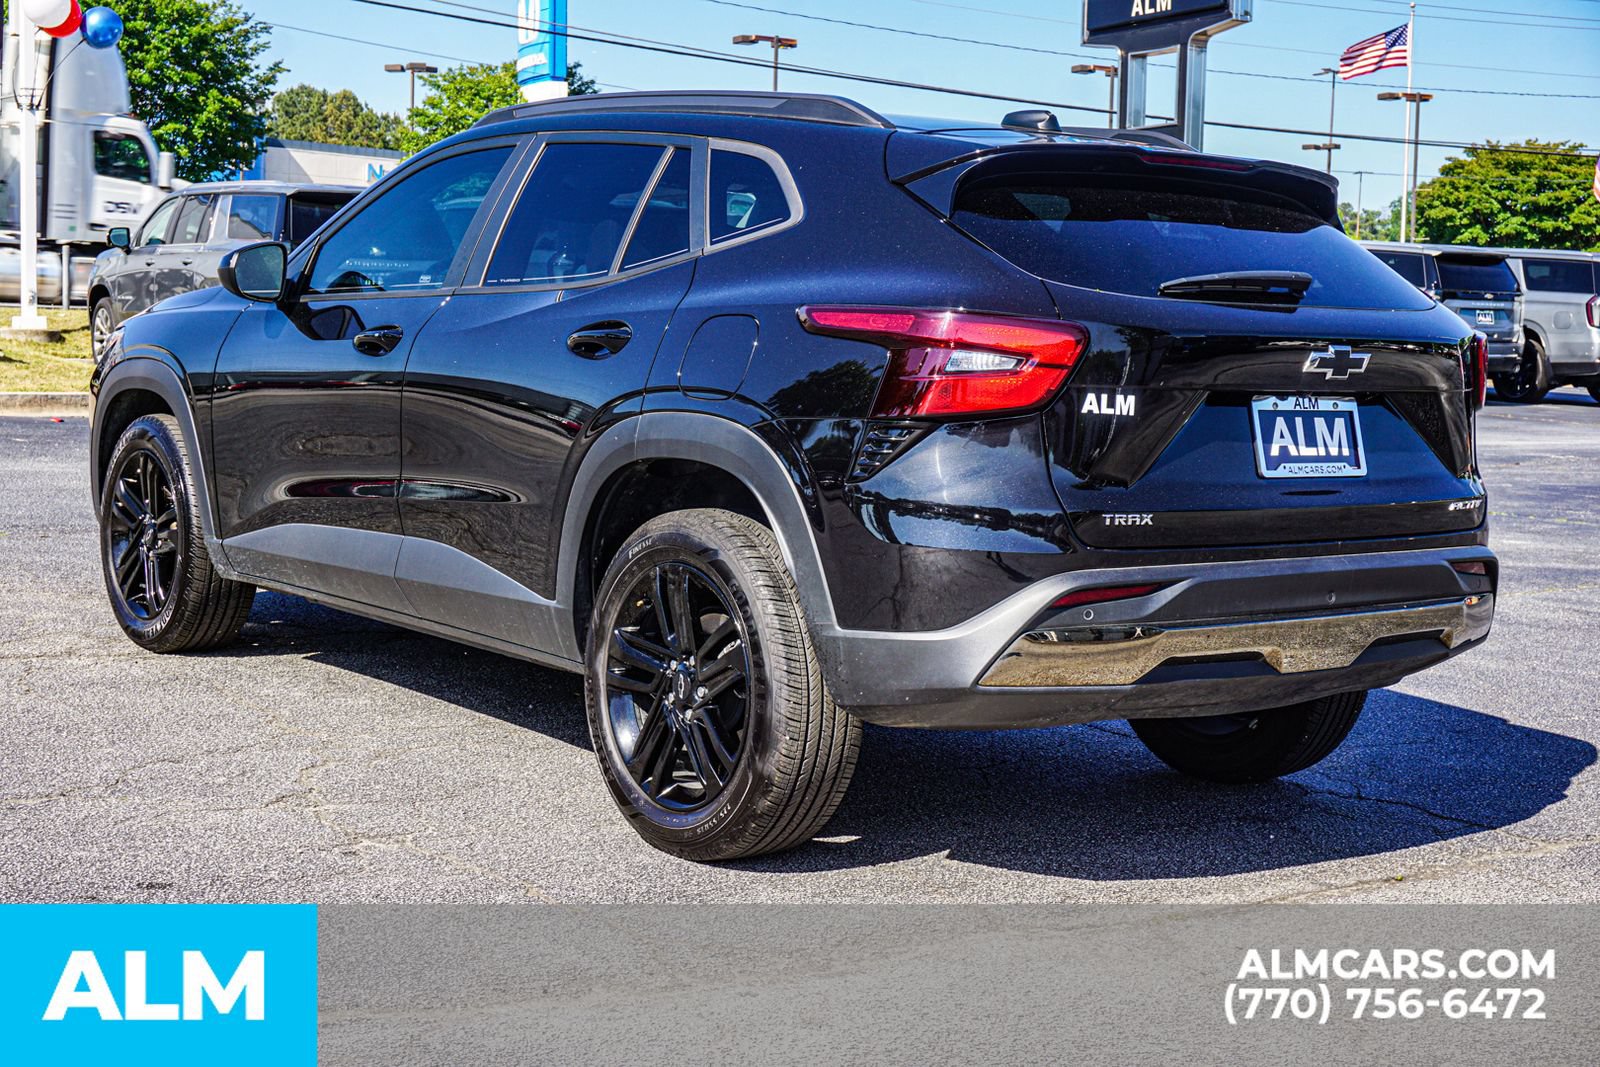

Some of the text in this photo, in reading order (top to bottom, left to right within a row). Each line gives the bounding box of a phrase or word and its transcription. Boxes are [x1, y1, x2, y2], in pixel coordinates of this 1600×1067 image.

[1131, 0, 1172, 16] ALM
[1081, 393, 1136, 416] ALM
[1293, 397, 1320, 410] ALM
[1270, 416, 1350, 457] ALM
[1288, 465, 1344, 475] ALMCARS.COM
[1102, 513, 1154, 526] TRAX
